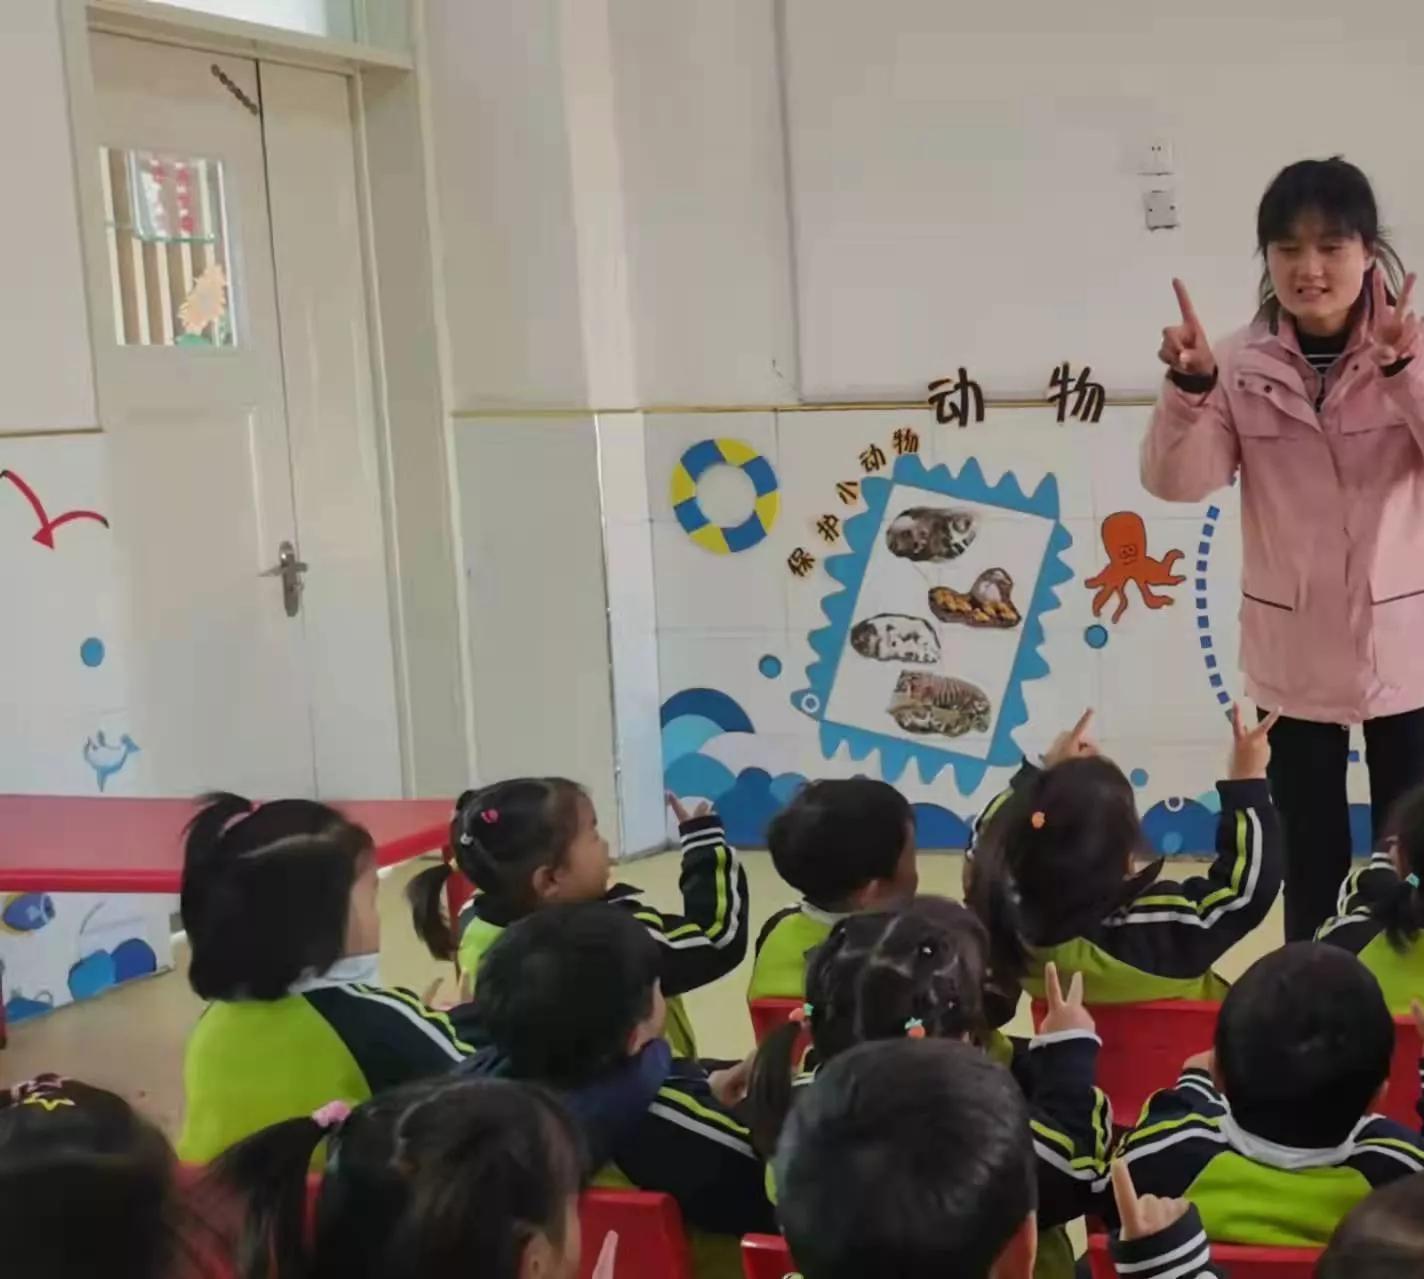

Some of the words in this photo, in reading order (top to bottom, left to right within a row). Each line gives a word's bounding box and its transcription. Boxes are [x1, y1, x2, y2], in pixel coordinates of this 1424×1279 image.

[926, 362, 1106, 427] 动物
[786, 427, 920, 578] 保护小动物
